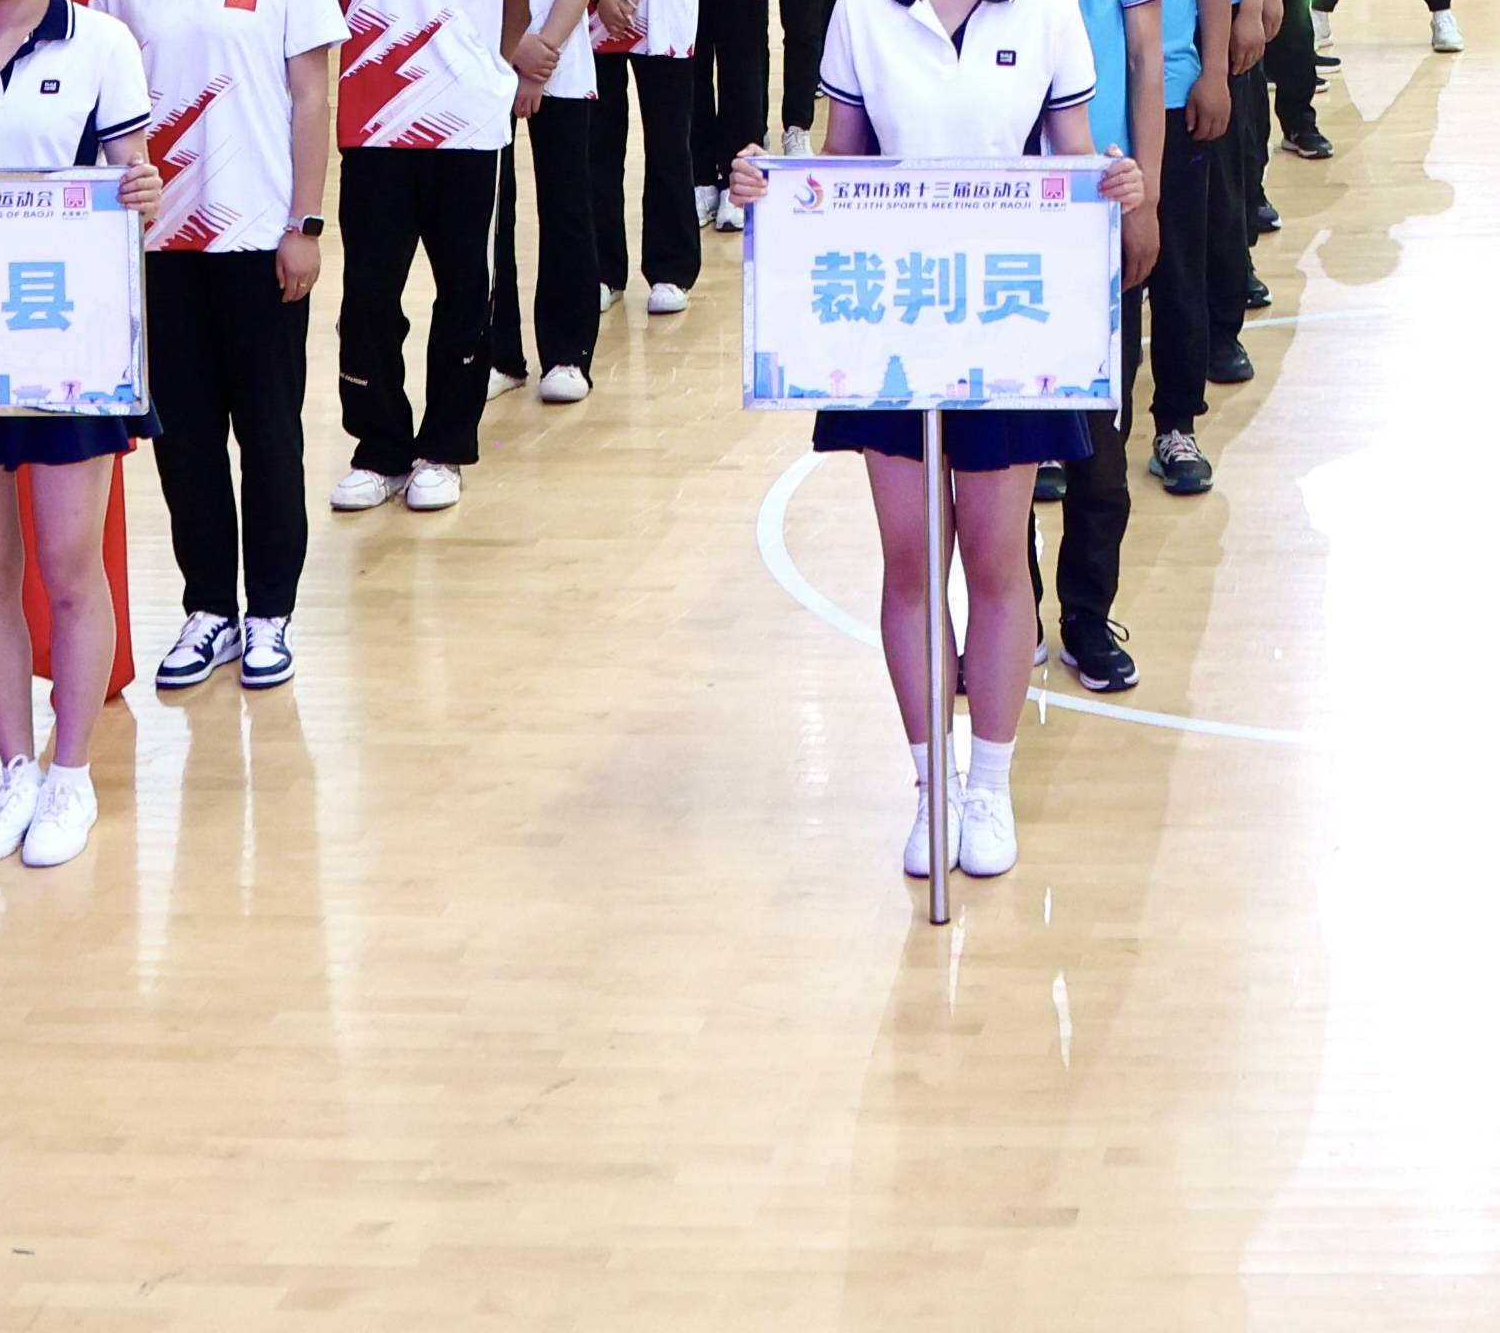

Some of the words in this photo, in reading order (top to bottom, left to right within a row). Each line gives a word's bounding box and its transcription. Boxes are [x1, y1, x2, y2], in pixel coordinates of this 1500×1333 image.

[832, 181, 1031, 199] 宝鸡市第十三届运动会
[832, 202, 852, 210] THE
[857, 202, 883, 210] 13TH
[886, 202, 929, 210] SPORTS
[931, 201, 980, 210] MEETING
[982, 202, 997, 210] OF
[1001, 202, 1032, 210] BAOJI
[810, 251, 1051, 325] 裁判员
